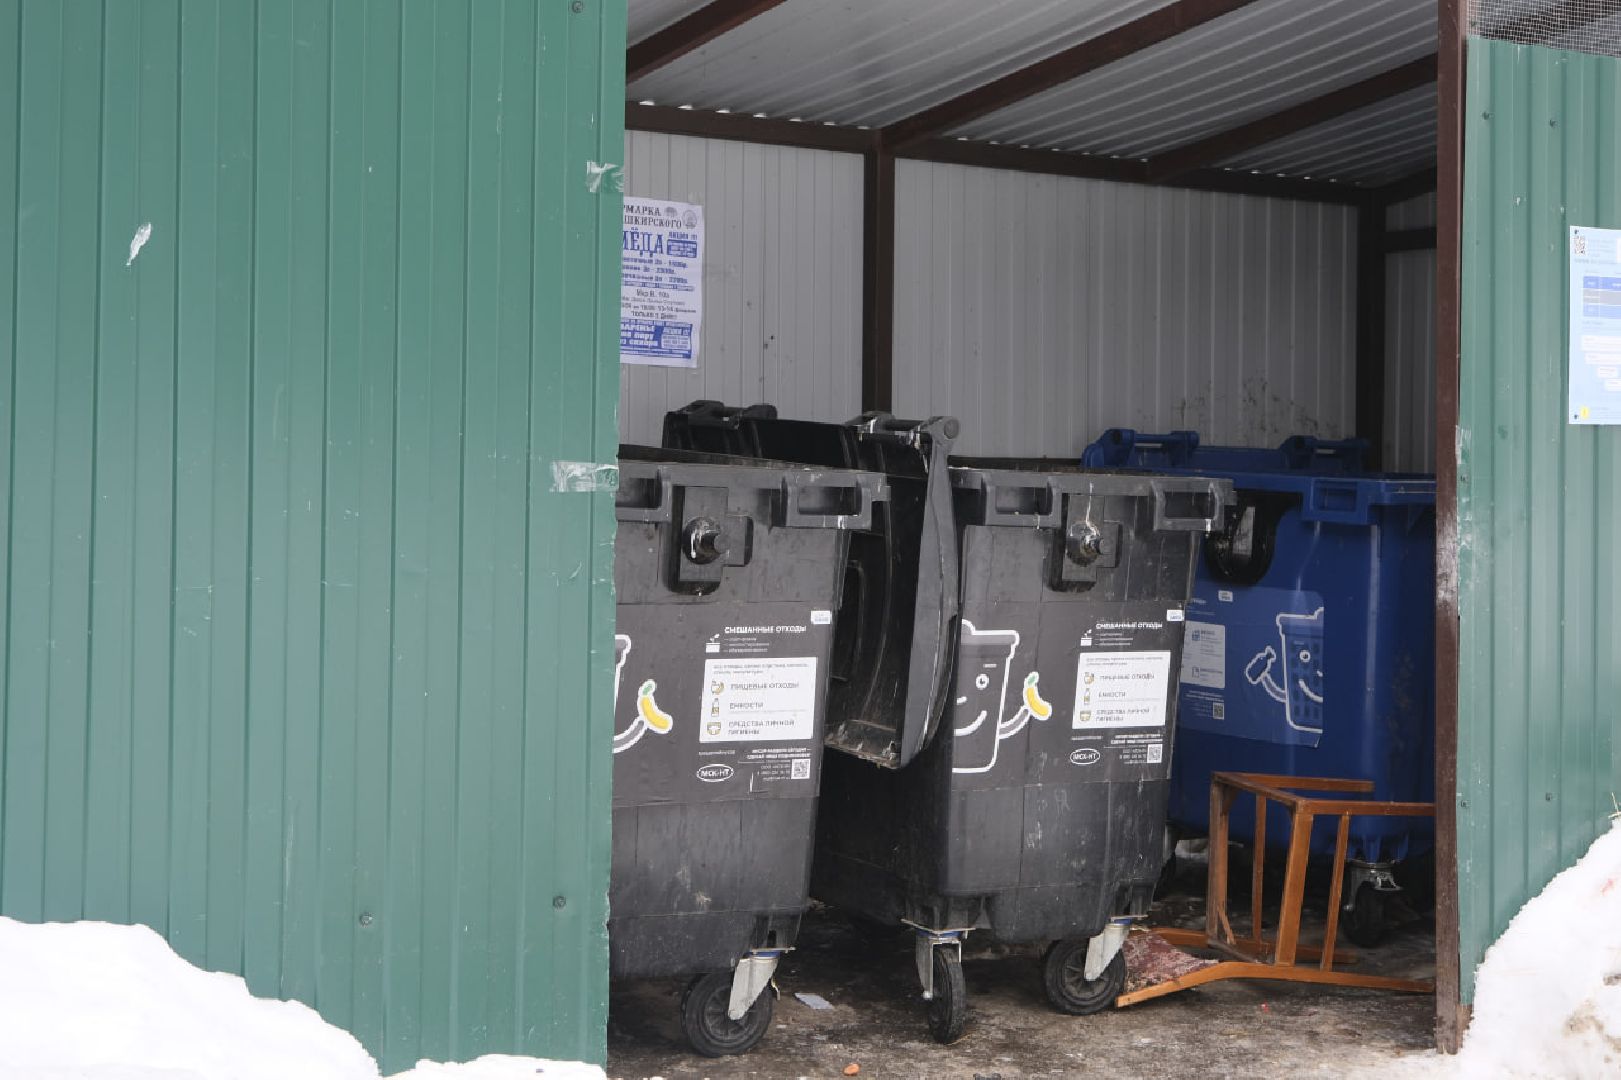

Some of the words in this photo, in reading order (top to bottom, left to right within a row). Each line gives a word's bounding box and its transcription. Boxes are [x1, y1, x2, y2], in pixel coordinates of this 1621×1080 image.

[624, 205, 661, 217] МАРКА
[724, 626, 774, 634] СМЕШАННЫЕ
[776, 625, 807, 634] ОТХОДЫ
